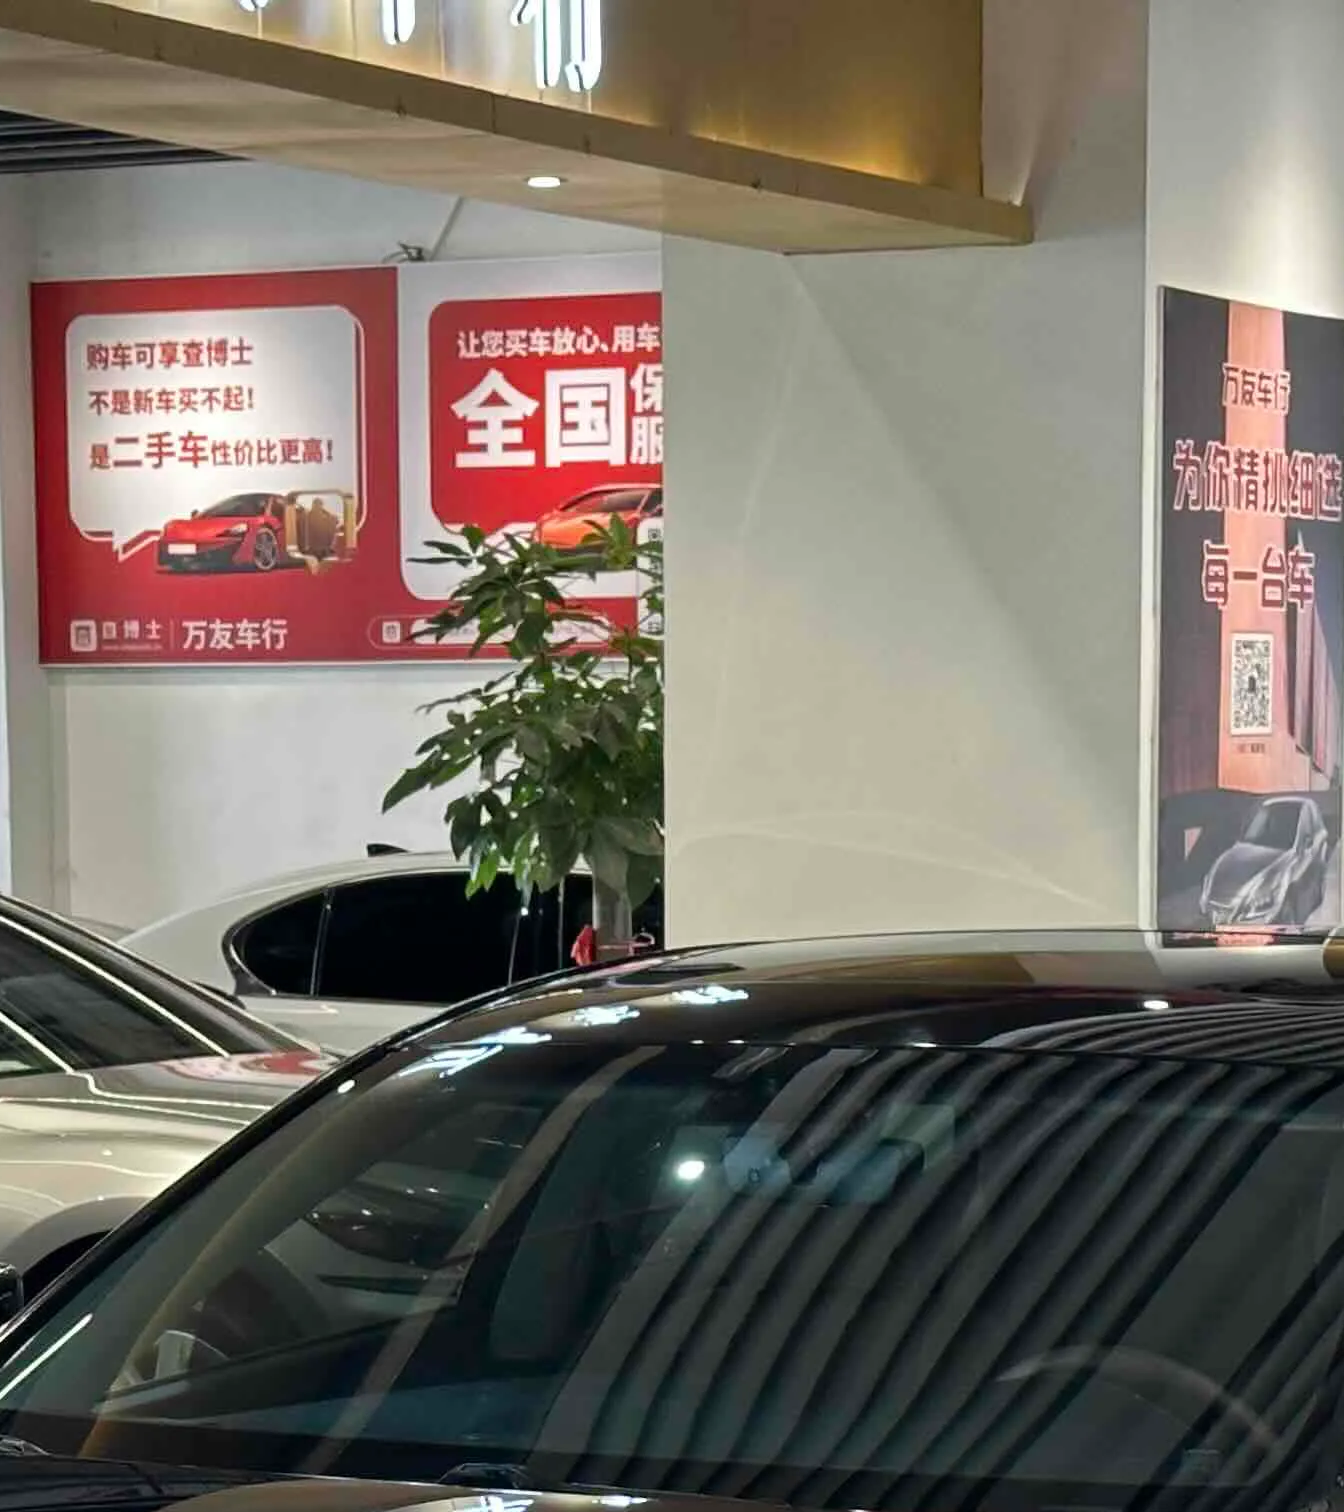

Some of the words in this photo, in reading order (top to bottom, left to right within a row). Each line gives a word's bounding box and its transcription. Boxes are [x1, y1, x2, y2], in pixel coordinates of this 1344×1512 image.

[86, 336, 254, 370] 购车可享查博士
[457, 321, 661, 359] 让您买车放心、用车
[88, 384, 254, 416] 不是新车买不起！
[1222, 363, 1291, 415] 万友车行
[450, 367, 625, 468] 全国
[89, 430, 334, 470] 是二手车性价比更高！
[1173, 439, 1343, 521] 为你精挑细选
[1202, 540, 1315, 611] 每一台车
[182, 618, 289, 650] 万友车行
